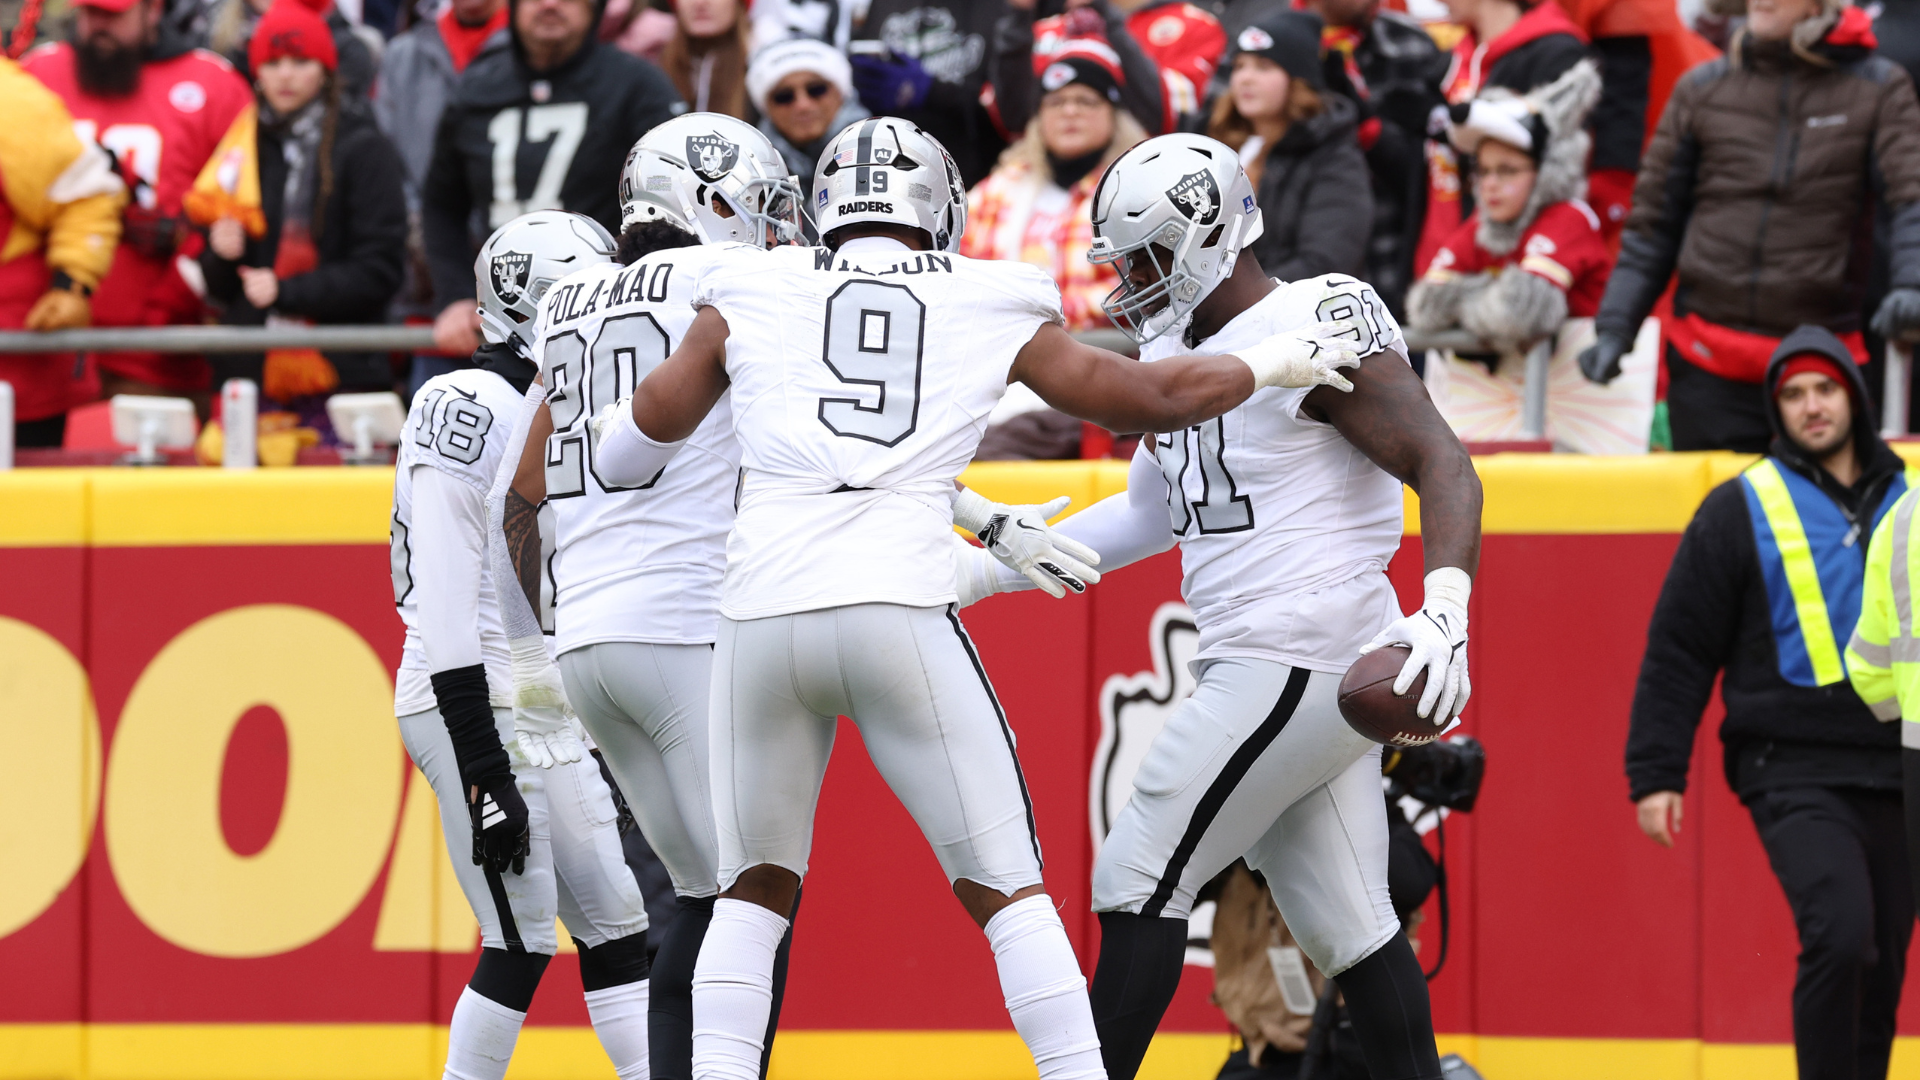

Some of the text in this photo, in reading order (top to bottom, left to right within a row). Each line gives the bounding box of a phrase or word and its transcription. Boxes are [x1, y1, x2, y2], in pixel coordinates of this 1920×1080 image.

[691, 137, 735, 150] RAIDERS
[876, 150, 890, 159] AL
[487, 102, 589, 230] 17
[872, 171, 888, 193] 9
[1170, 170, 1208, 197] RAIDERS
[838, 202, 894, 217] RAIDERS
[494, 254, 529, 264] RAIDERS
[544, 262, 674, 331] POLA-MAO
[818, 279, 926, 448] 9
[415, 388, 494, 466] 18
